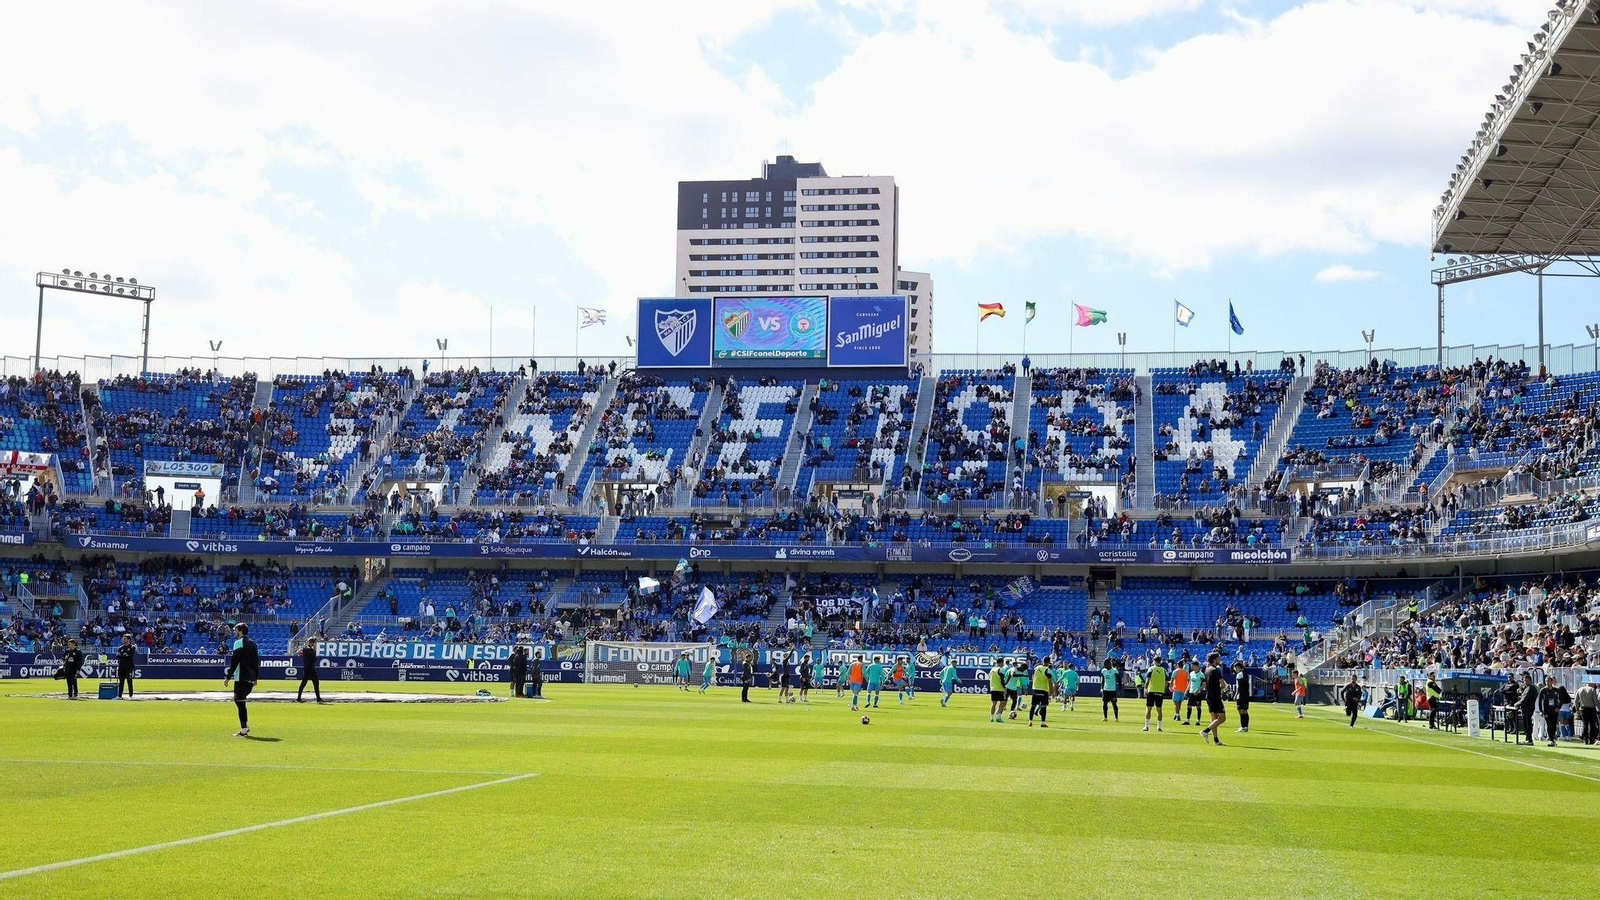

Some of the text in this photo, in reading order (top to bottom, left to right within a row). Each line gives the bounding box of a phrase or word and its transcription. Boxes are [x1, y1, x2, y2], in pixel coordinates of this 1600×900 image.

[758, 317, 781, 331] VS
[730, 350, 808, 358] #CSIFconelDeporte
[162, 462, 209, 472] LOS 300
[91, 540, 129, 549] Sanamar
[202, 543, 238, 552] vithas
[490, 546, 532, 554] SohoBoutique
[590, 547, 618, 556] Halcón
[1178, 551, 1214, 559] campano
[1231, 549, 1287, 560] micolchón
[816, 598, 851, 607] LOS DE
[316, 642, 407, 659] EREDEROS
[413, 643, 436, 659] DE
[441, 644, 467, 660] UN
[607, 648, 673, 663] FONDO
[34, 654, 66, 665] famades
[260, 658, 293, 667] mmel
[29, 666, 57, 676] trafile
[574, 662, 608, 671] capano
[651, 663, 673, 672] camp
[462, 671, 499, 681] vithas
[541, 672, 562, 682] iguel
[590, 673, 626, 683] hummel
[954, 684, 988, 694] beebé
